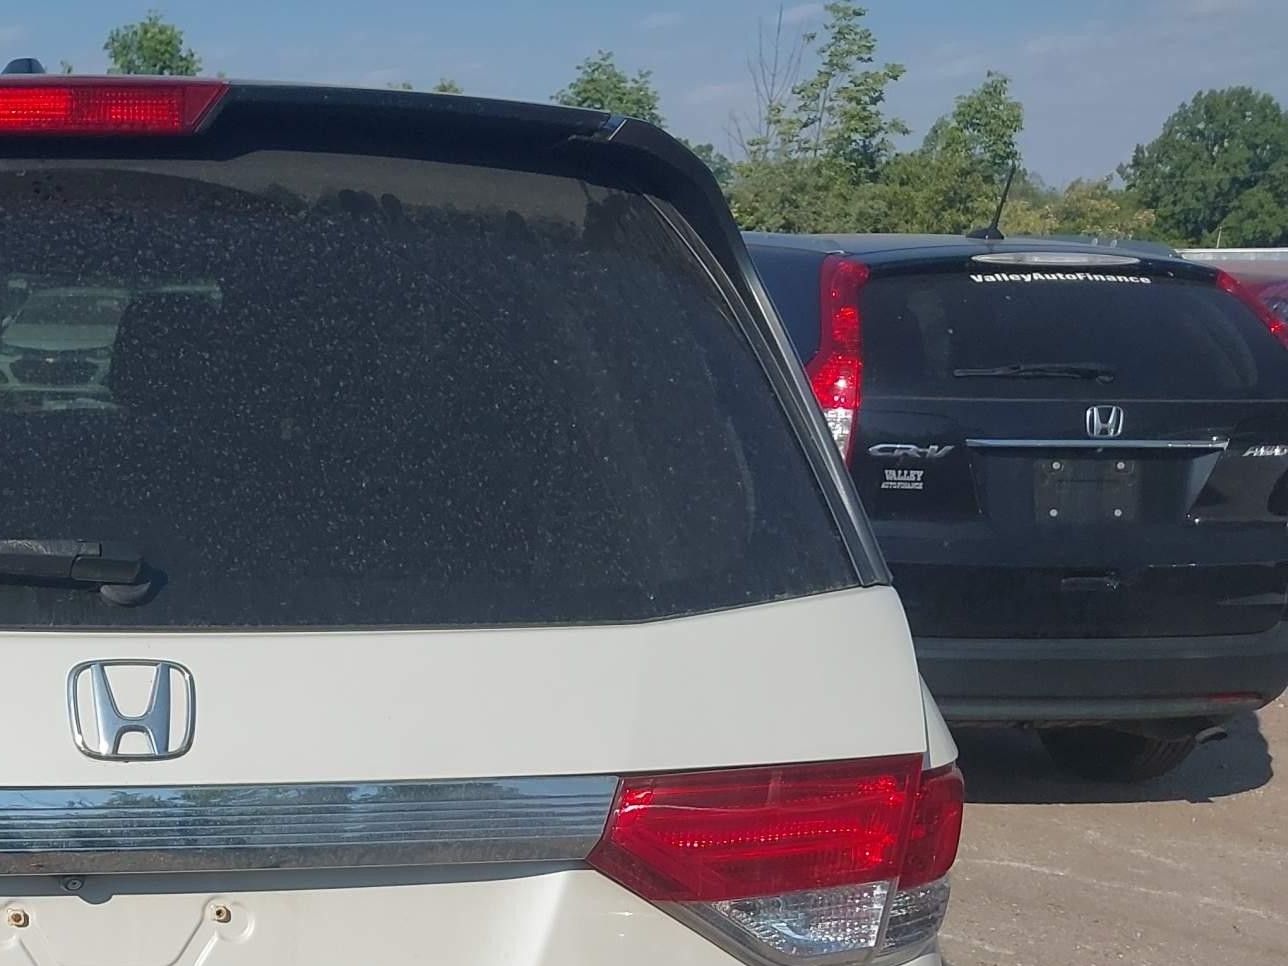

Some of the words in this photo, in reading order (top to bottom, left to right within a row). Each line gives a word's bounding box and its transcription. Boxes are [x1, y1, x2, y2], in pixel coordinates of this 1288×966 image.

[970, 272, 1152, 284] ValleyAutoFinance
[868, 443, 955, 458] CR-V
[884, 469, 924, 481] VALLEY
